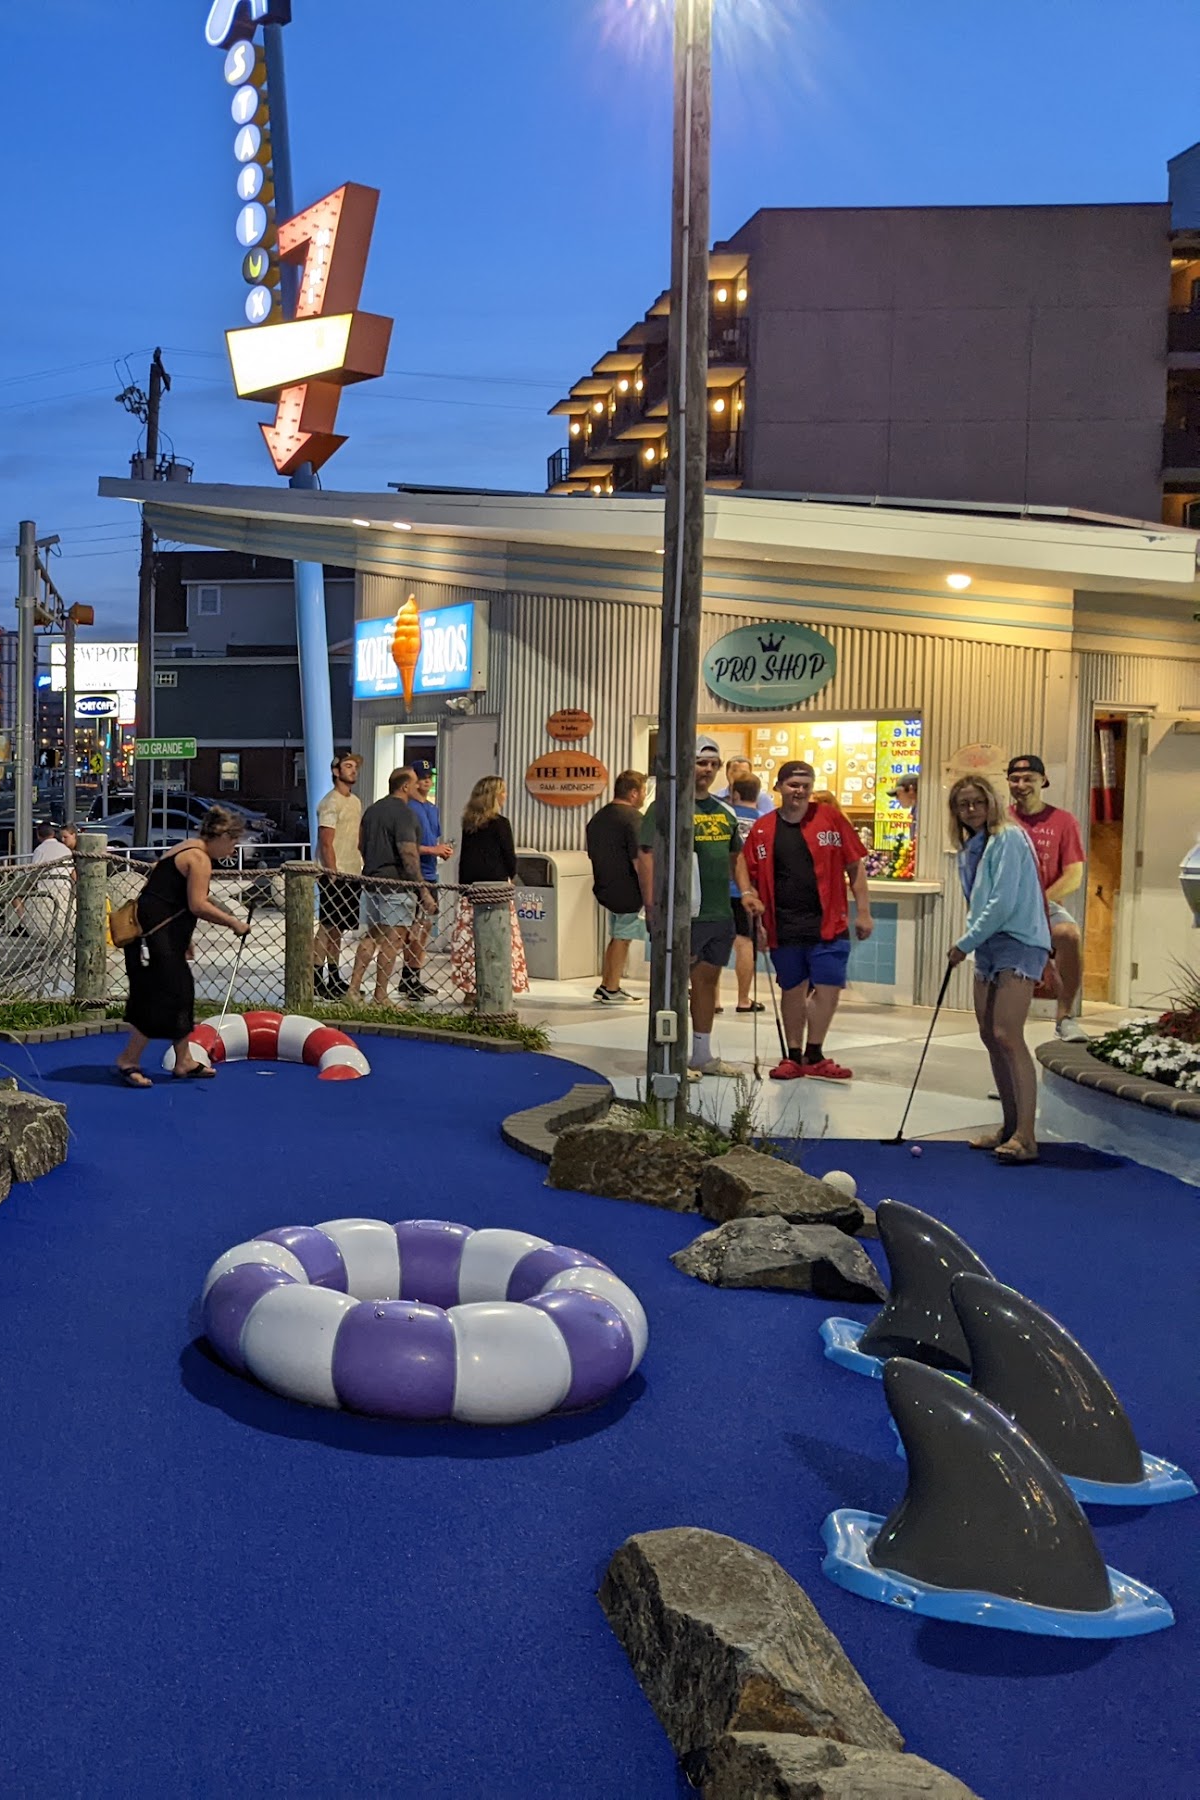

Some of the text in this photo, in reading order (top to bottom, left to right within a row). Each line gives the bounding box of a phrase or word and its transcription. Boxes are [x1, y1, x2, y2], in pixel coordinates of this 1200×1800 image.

[228, 44, 265, 320] STARLUX
[308, 228, 330, 305] MINI
[715, 653, 825, 683] PRO SHOP
[893, 728, 902, 737] 9
[136, 743, 150, 754] RIO
[150, 742, 183, 754] GRANDE
[891, 740, 907, 748] YRS
[422, 760, 431, 770] B
[891, 764, 903, 774] 18
[535, 766, 602, 778] TEE TIME
[560, 783, 595, 791] MIDNIGHT
[1032, 827, 1055, 836] CALL
[816, 830, 842, 847] SOX
[1037, 839, 1050, 847] ME
[517, 909, 546, 920] GOLF
